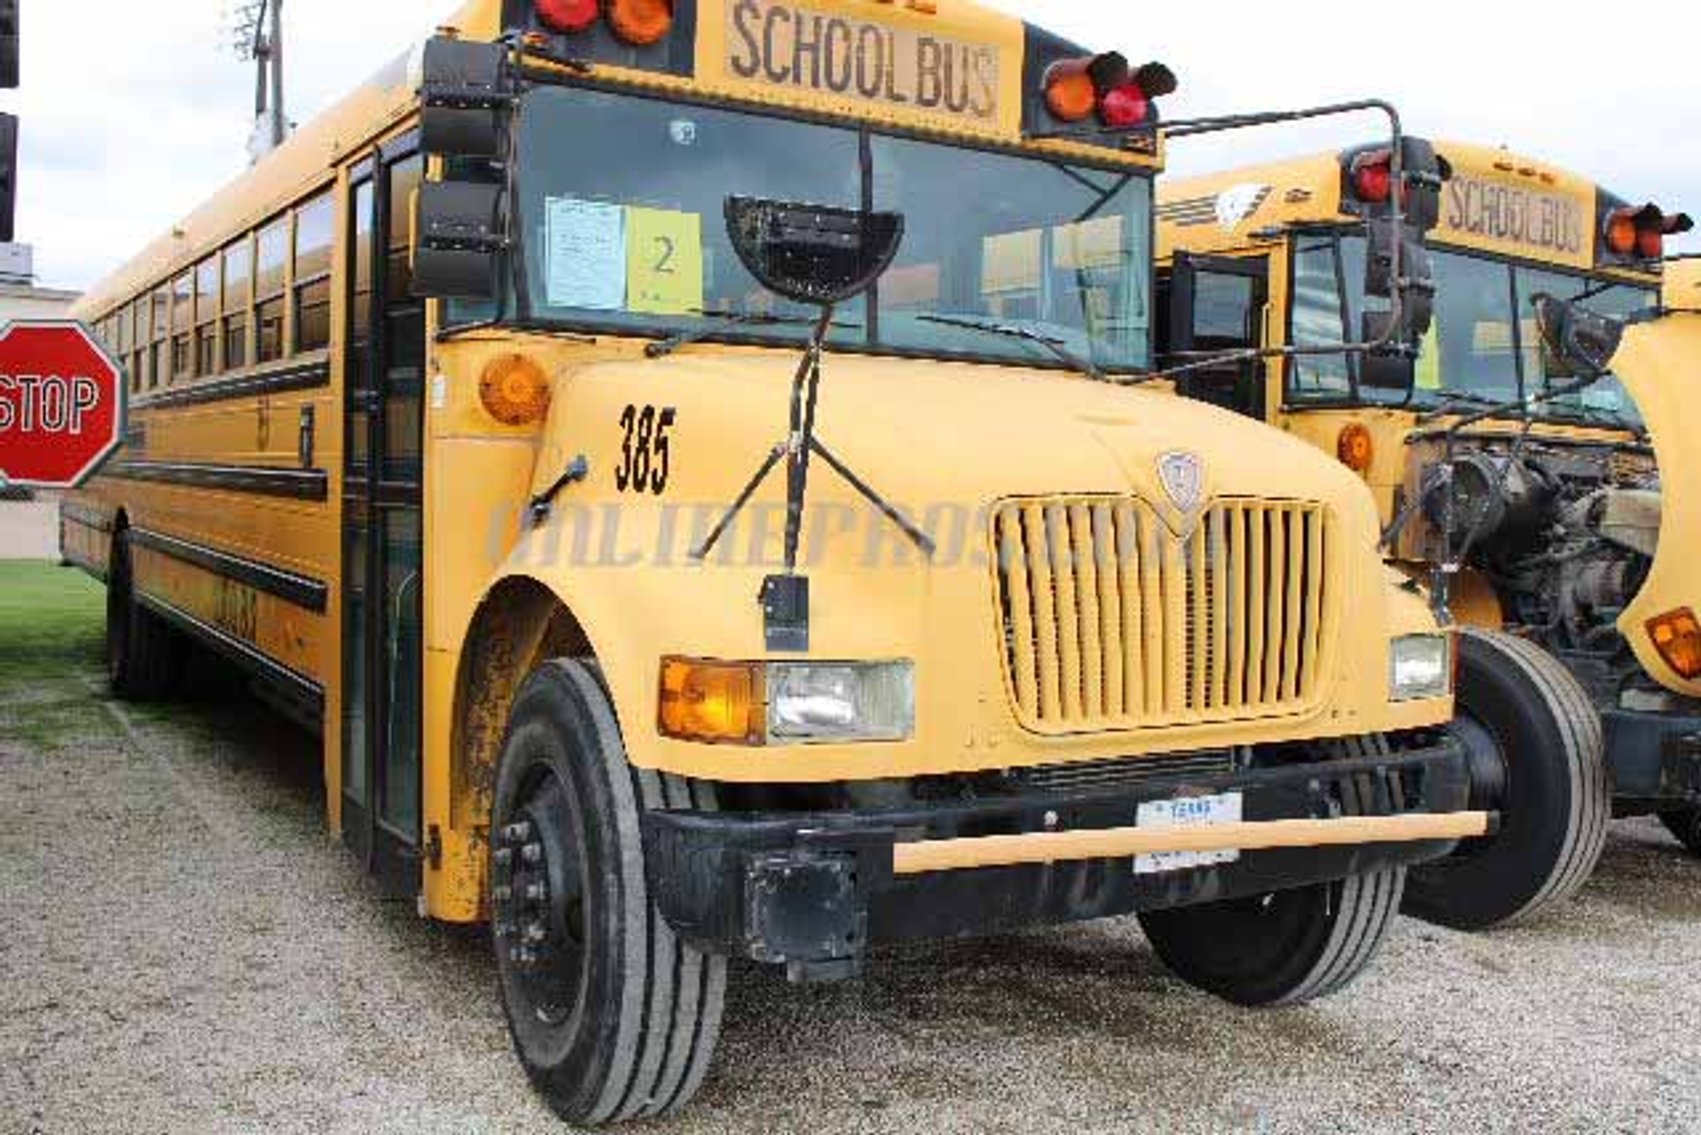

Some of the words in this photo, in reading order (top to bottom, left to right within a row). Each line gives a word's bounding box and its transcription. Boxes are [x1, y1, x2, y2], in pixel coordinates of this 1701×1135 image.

[731, 0, 907, 102] SCHOOL
[916, 37, 997, 118] BUS
[1449, 176, 1537, 242] SCHOOL
[1540, 196, 1583, 253] BUS
[653, 235, 675, 274] 2
[0, 375, 98, 434] STOP
[615, 404, 675, 495] 385
